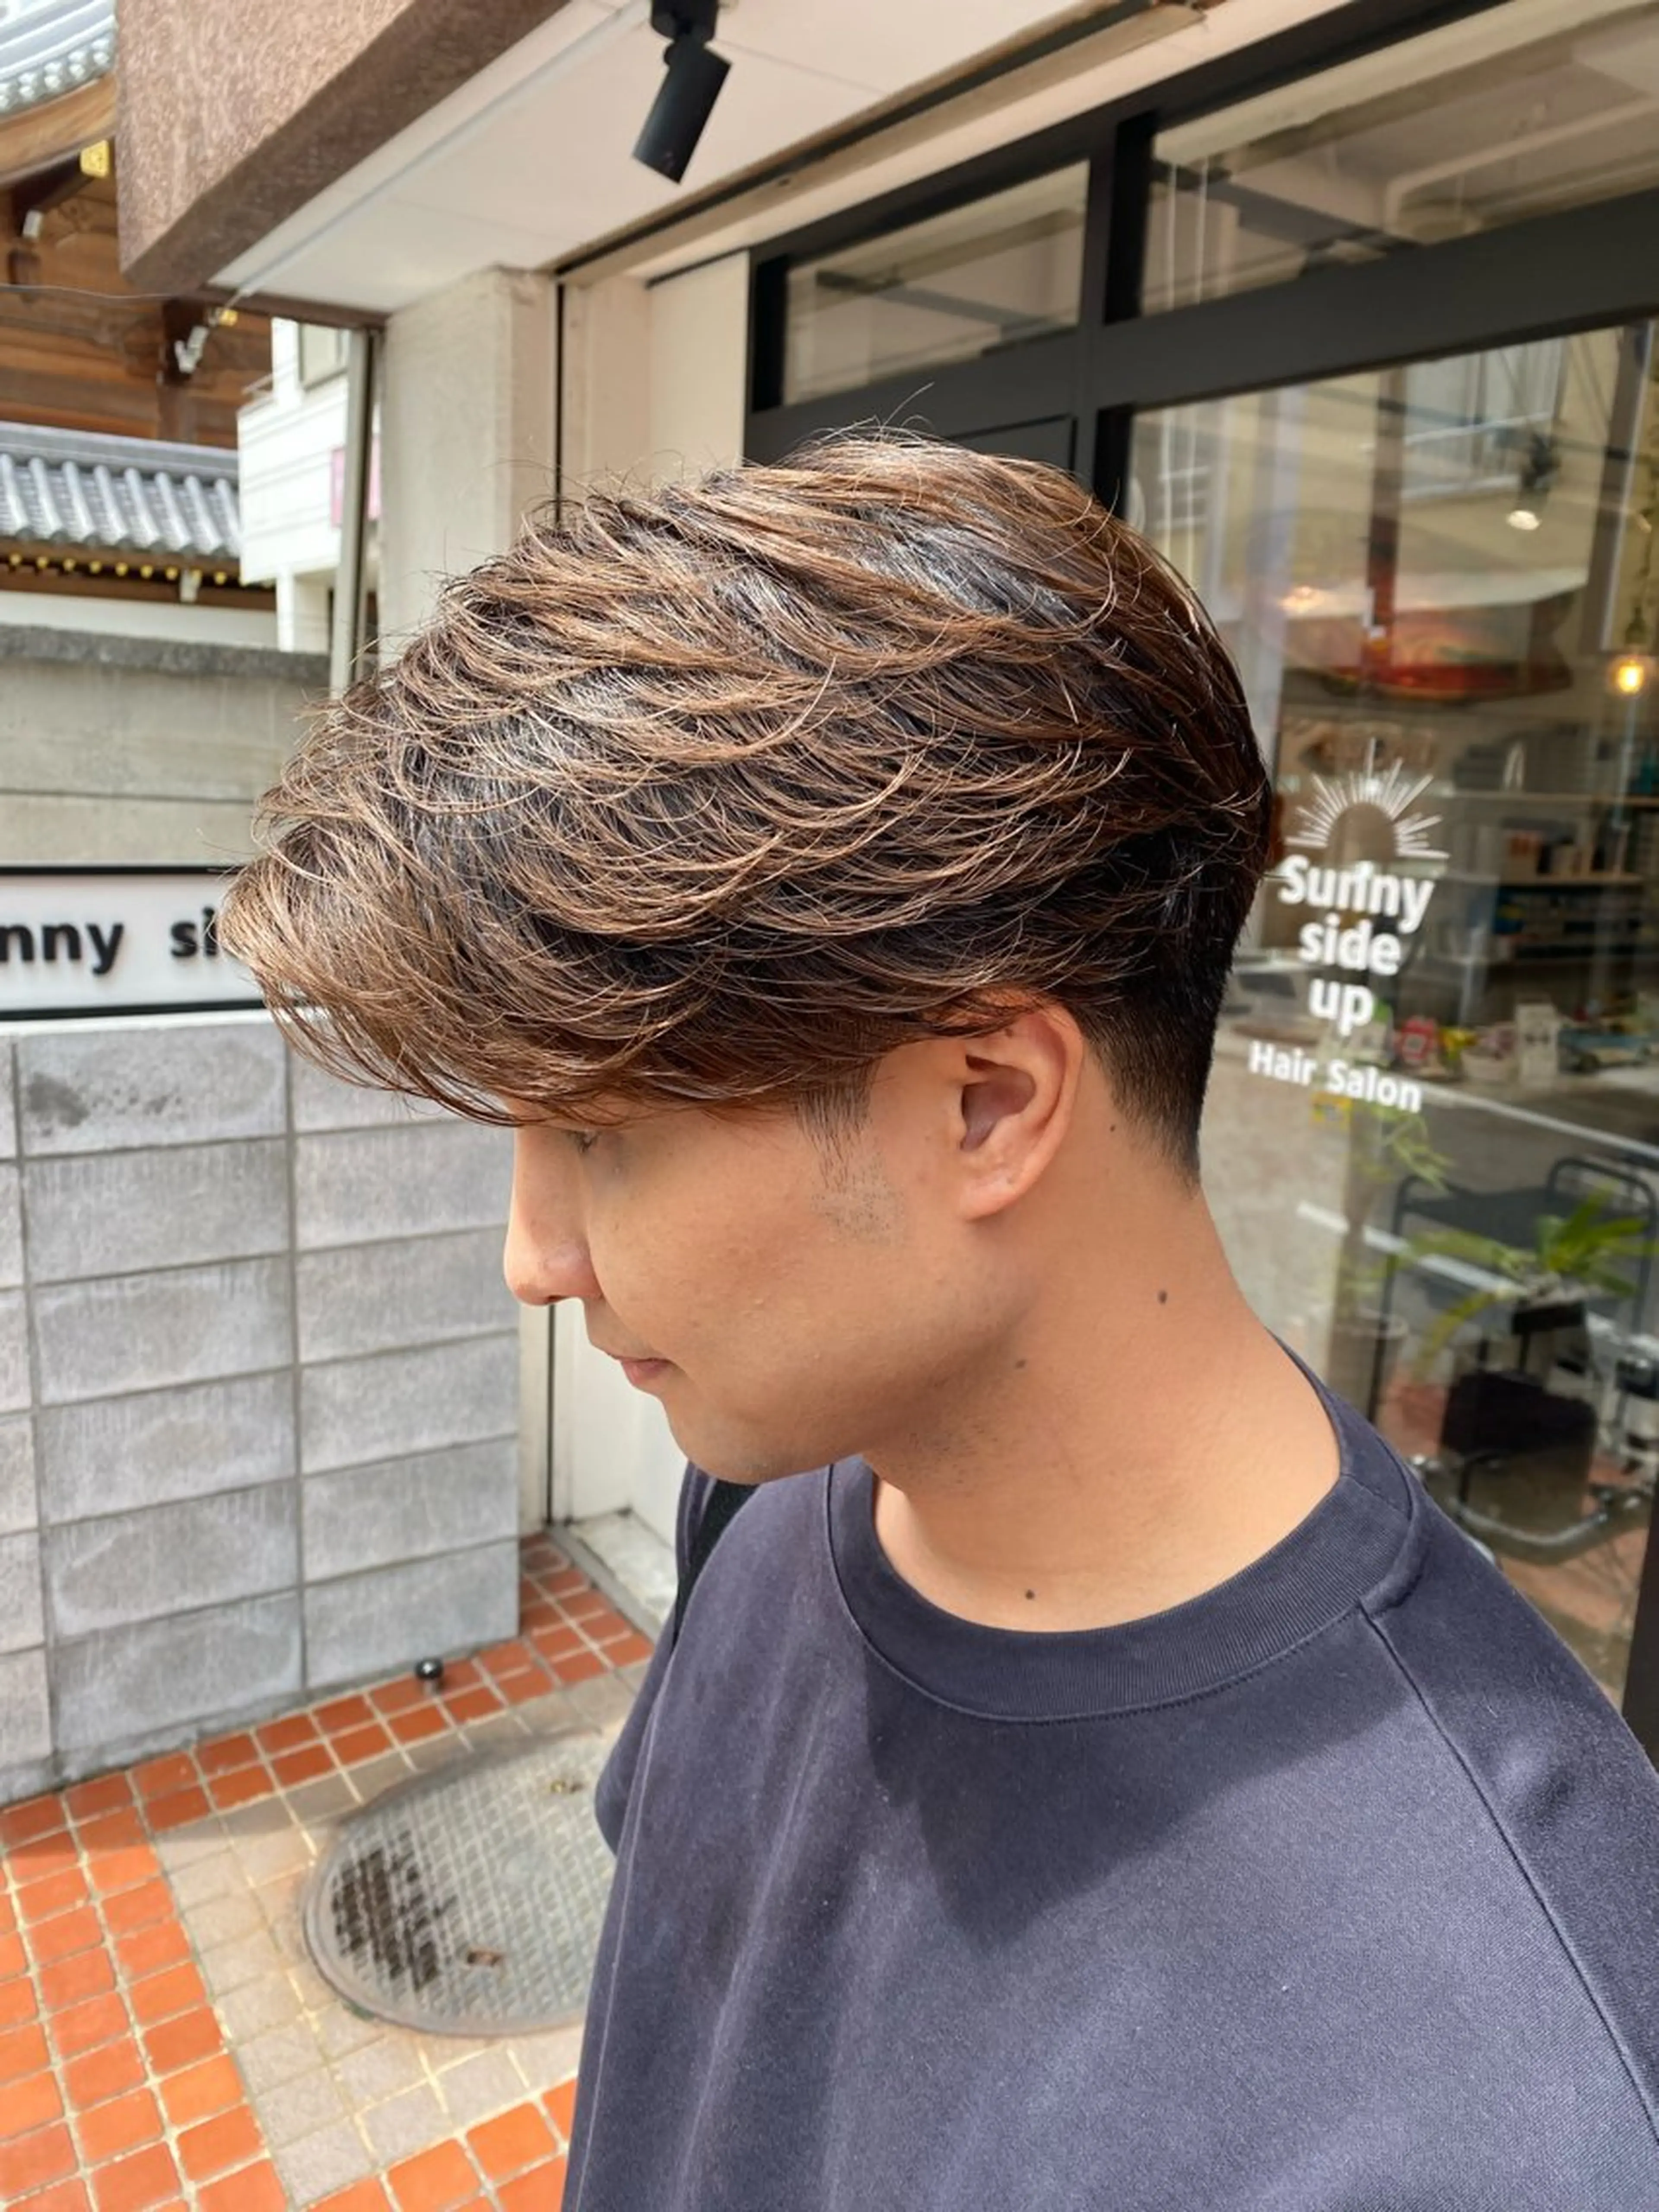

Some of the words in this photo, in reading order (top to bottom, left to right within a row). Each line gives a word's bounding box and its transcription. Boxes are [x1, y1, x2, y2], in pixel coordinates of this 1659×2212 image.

[1278, 854, 1435, 934] Sunny
[1300, 912, 1401, 975] side
[1309, 978, 1375, 1036] up
[1249, 1041, 1317, 1086] Hair
[1325, 1058, 1421, 1114] Salon
